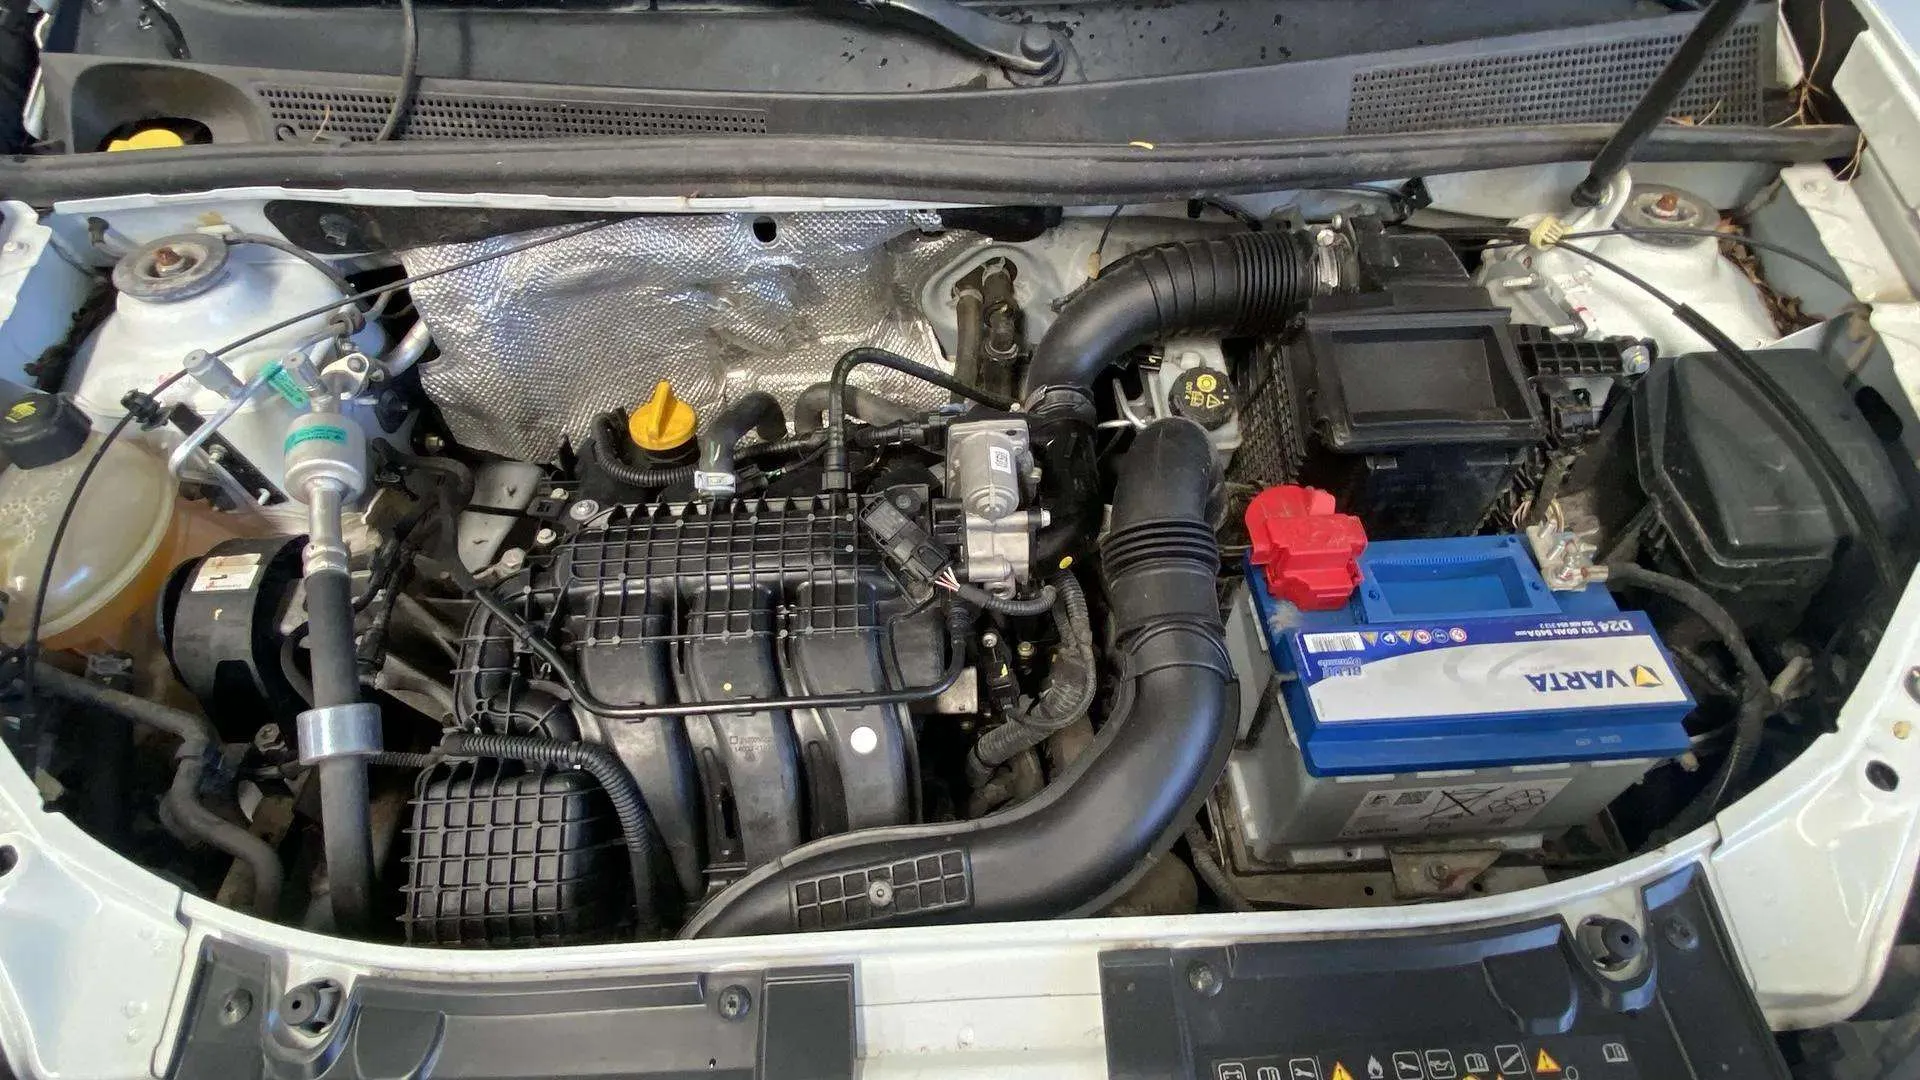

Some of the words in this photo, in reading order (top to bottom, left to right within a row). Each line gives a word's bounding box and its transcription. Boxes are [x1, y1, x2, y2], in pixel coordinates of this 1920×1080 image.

[1581, 626, 1599, 635] 12V
[1598, 620, 1633, 632] D24
[1524, 670, 1630, 692] VARTA
